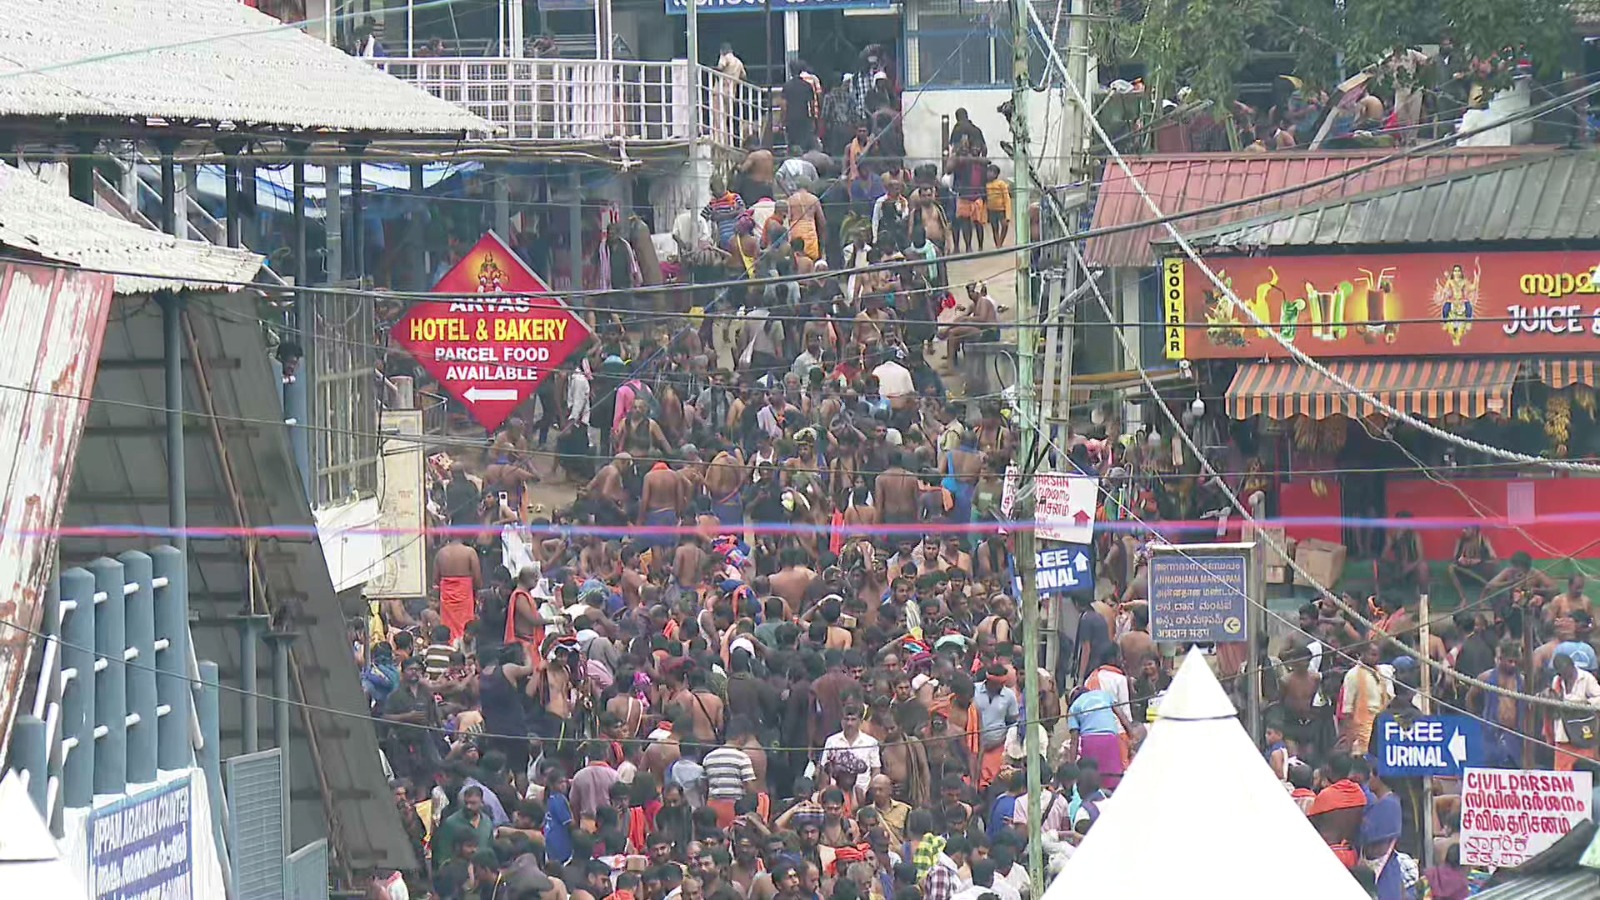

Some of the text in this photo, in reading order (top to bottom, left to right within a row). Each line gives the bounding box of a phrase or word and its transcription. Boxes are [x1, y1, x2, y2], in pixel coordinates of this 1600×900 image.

[1502, 304, 1584, 334] JUICE
[410, 318, 567, 341] HOTEL & BAKERY
[435, 347, 549, 361] PARCEL FOOD
[446, 366, 538, 380] AVAILABLE
[1154, 574, 1240, 584] ANNADHANA MANDAPAM
[1384, 721, 1443, 742] FREE
[1386, 745, 1447, 767] URINAL
[1467, 772, 1575, 792] CIVIL DARSAN
